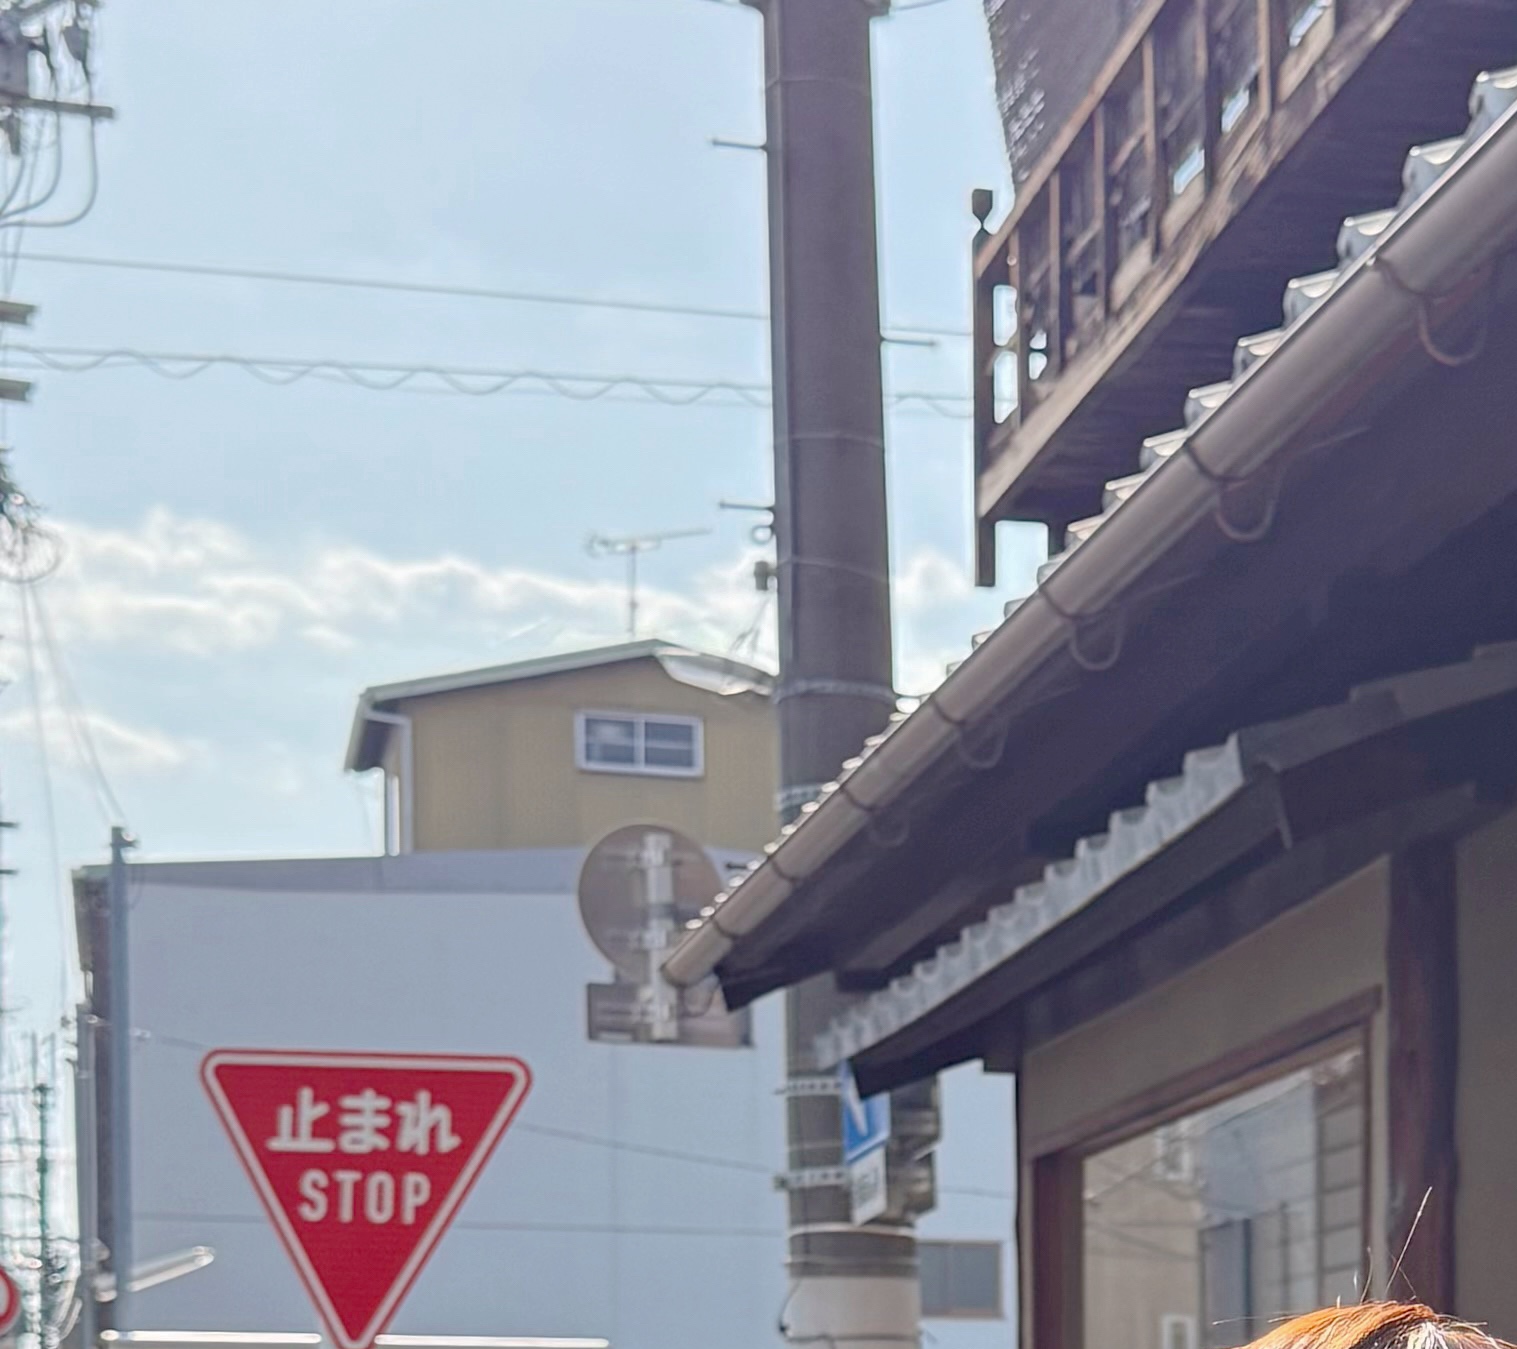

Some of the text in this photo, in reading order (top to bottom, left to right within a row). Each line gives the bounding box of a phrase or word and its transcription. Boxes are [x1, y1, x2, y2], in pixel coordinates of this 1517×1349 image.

[267, 1087, 462, 1155] 止まれ
[299, 1168, 431, 1225] STOP
